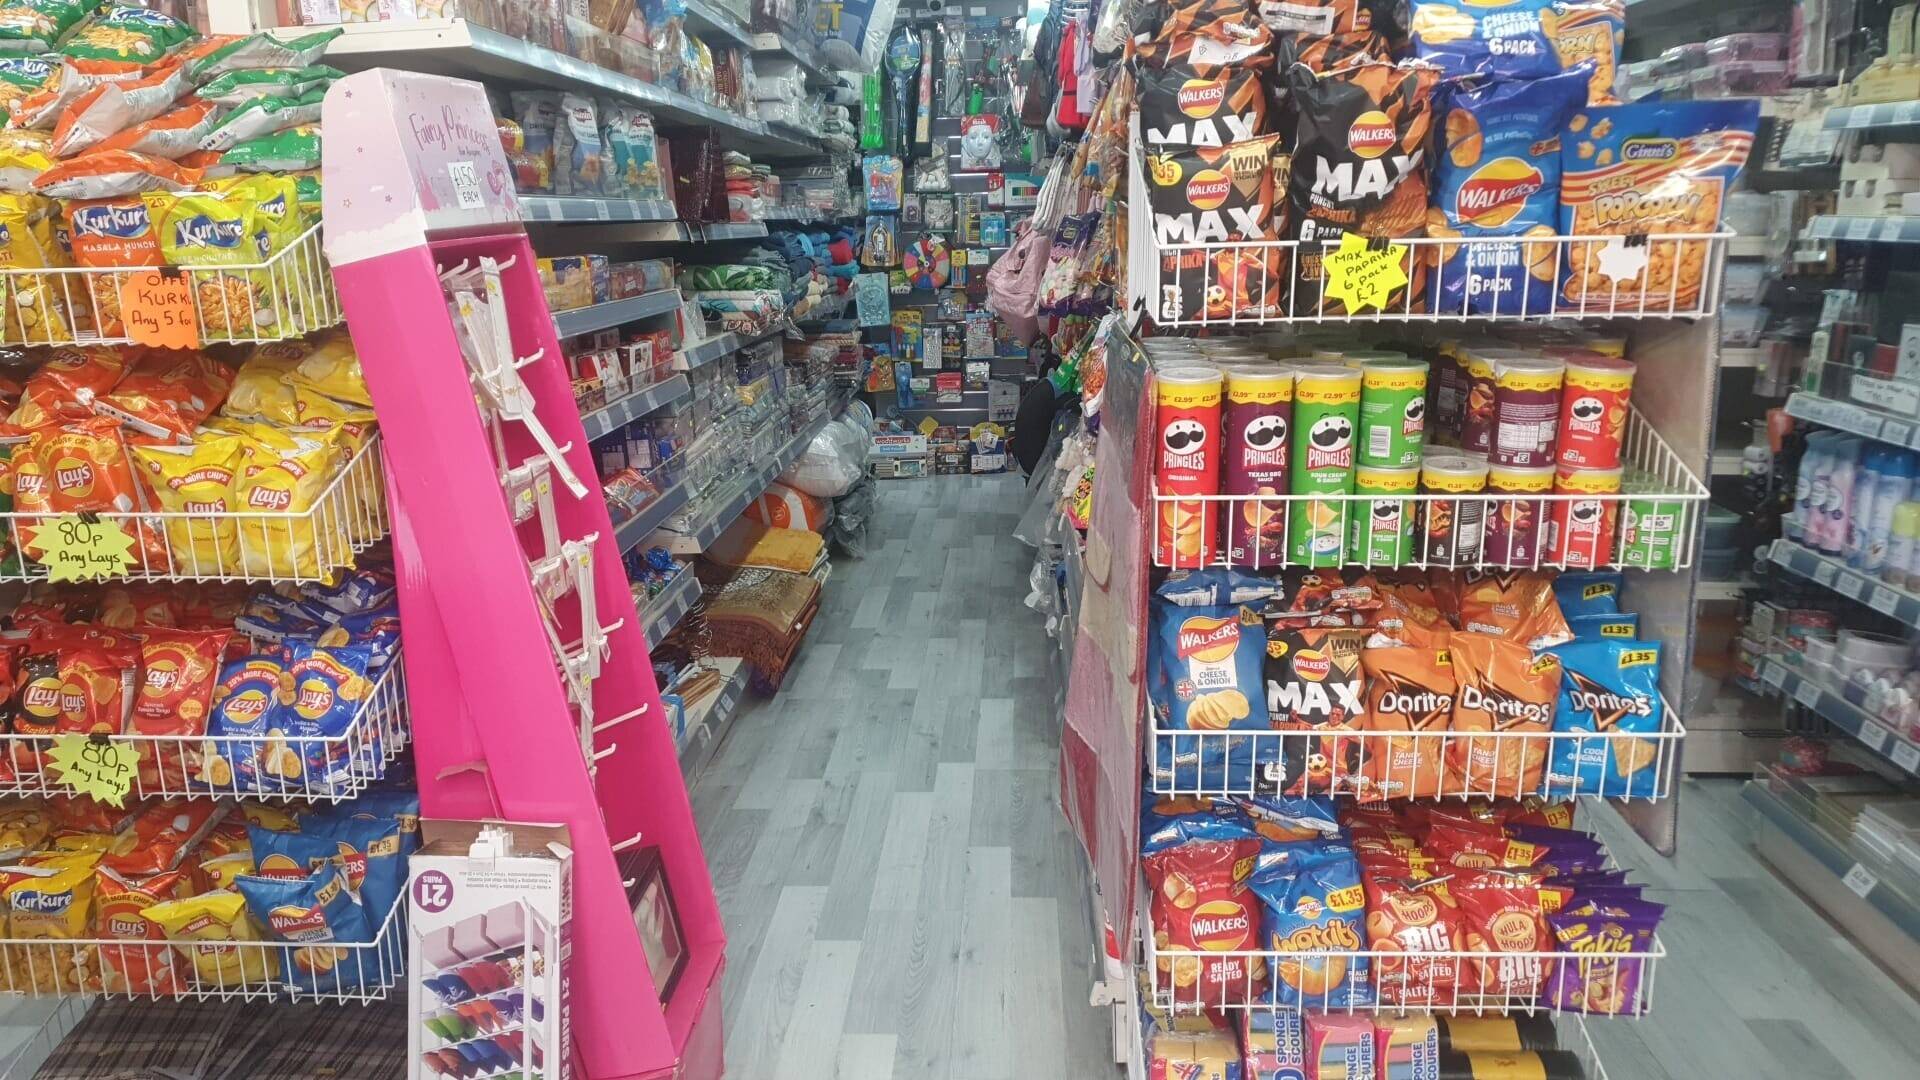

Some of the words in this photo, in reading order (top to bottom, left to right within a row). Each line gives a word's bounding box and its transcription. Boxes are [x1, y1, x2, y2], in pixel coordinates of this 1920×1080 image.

[1483, 11, 1535, 28] CHEESE
[1489, 38, 1503, 55] 6
[1505, 40, 1536, 54] PACK
[1180, 87, 1222, 104] WALKERS
[409, 113, 447, 151] Fairy
[1148, 112, 1257, 147] MAX
[1350, 128, 1394, 144] WALKERS
[1233, 155, 1266, 170] WIN
[1312, 149, 1424, 201] MAX
[1189, 182, 1229, 196] WALKERS
[1461, 180, 1542, 209] WALKERS
[1595, 190, 1702, 225] POPCORN
[1155, 204, 1265, 245] MAX
[1301, 219, 1316, 241] 6
[83, 244, 120, 253] MASALA
[1335, 250, 1362, 264] MAX
[1477, 251, 1519, 266] ONION
[1346, 246, 1397, 276] PAPRIKA
[1344, 280, 1354, 290] 6
[1356, 282, 1379, 302] £2
[1469, 275, 1481, 296] 6
[1483, 277, 1512, 291] PACK
[132, 310, 159, 333] Any
[164, 311, 174, 326] 5
[1569, 418, 1601, 434] PRINGLES
[1163, 450, 1204, 471] PRINGLES
[1244, 447, 1286, 466] PRINGLES
[1308, 448, 1350, 467] PRINGLES
[16, 473, 43, 496] Lay
[184, 472, 206, 484] MORE
[206, 471, 229, 483] CHIPS
[250, 486, 290, 509] Lay's
[58, 521, 103, 547] 80p
[59, 550, 87, 569] Any
[88, 549, 121, 570] Lays
[1585, 583, 1612, 596] £1.35
[1181, 623, 1239, 650] WALKERS
[1602, 625, 1629, 634] £1.35
[1331, 639, 1361, 650] WIN
[306, 661, 325, 670] MORE
[1295, 659, 1329, 669] WALKERS
[1621, 652, 1650, 665] £1.35
[228, 675, 242, 687] 20%
[243, 670, 261, 680] MORE
[1199, 670, 1227, 678] CHEESE
[1204, 677, 1230, 685] ONION
[27, 686, 60, 706] Lay
[1268, 679, 1364, 716] MAX
[1380, 692, 1451, 713] Dorito
[1463, 684, 1550, 722] Doritos
[1569, 690, 1651, 717] Doritos
[82, 741, 129, 777] 80p
[71, 762, 92, 782] Any
[97, 771, 125, 795] Lays
[1506, 847, 1531, 861] £1.35
[10, 890, 72, 912] Kurkure
[422, 884, 448, 907] 21
[1330, 889, 1362, 908] £1.35
[1402, 901, 1434, 921] HOOPS
[111, 919, 145, 934] Lay's
[1192, 914, 1248, 937] WALKERS
[1501, 920, 1526, 935] HULA
[1405, 921, 1450, 952] BIG
[1501, 935, 1534, 950] HOOPS
[1211, 961, 1240, 973] READY
[1418, 966, 1452, 980] SALTED
[1500, 955, 1542, 981] BIG
[562, 976, 570, 1000] 21
[1398, 985, 1435, 998] SALTED
[562, 1004, 570, 1061] PAIRS
[1276, 1011, 1287, 1063] SPONGE
[1413, 1042, 1423, 1080] PONGE
[1427, 1028, 1437, 1080] COURERS
